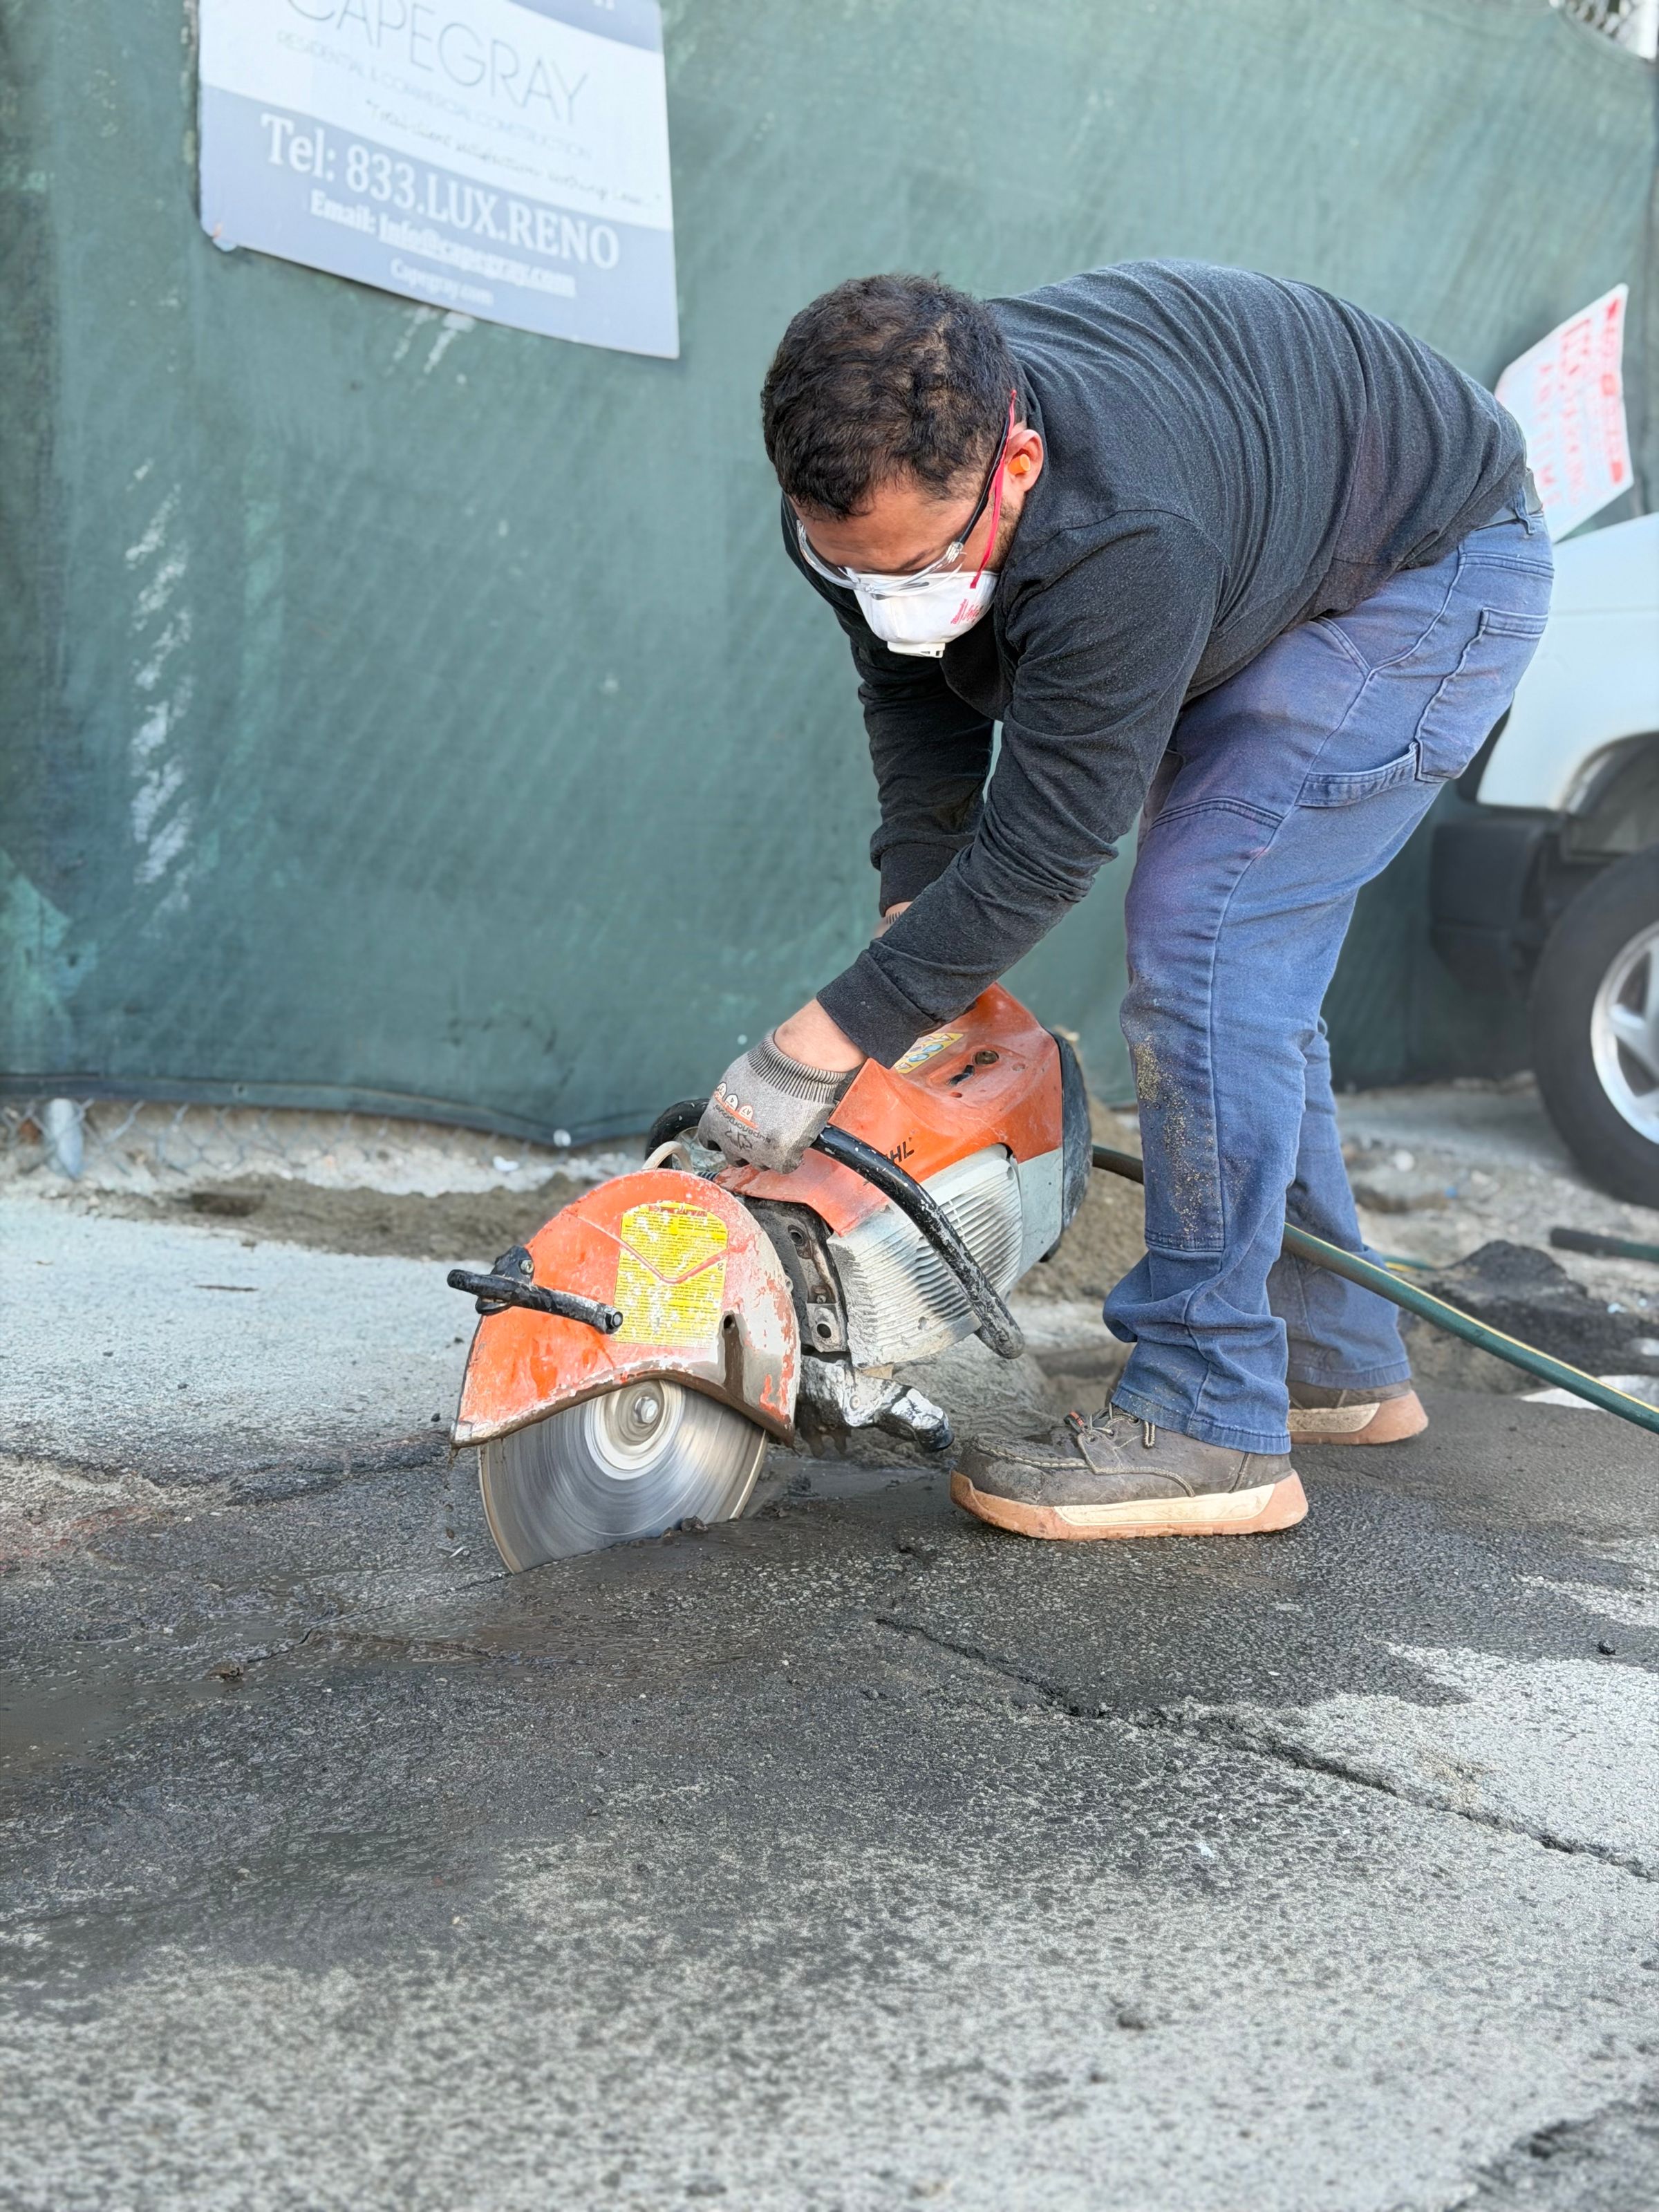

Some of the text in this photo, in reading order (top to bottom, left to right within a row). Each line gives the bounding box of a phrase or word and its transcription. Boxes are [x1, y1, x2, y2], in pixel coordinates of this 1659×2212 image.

[261, 113, 619, 270] Tel: 833.LUX.RENO
[310, 190, 375, 235] Email:
